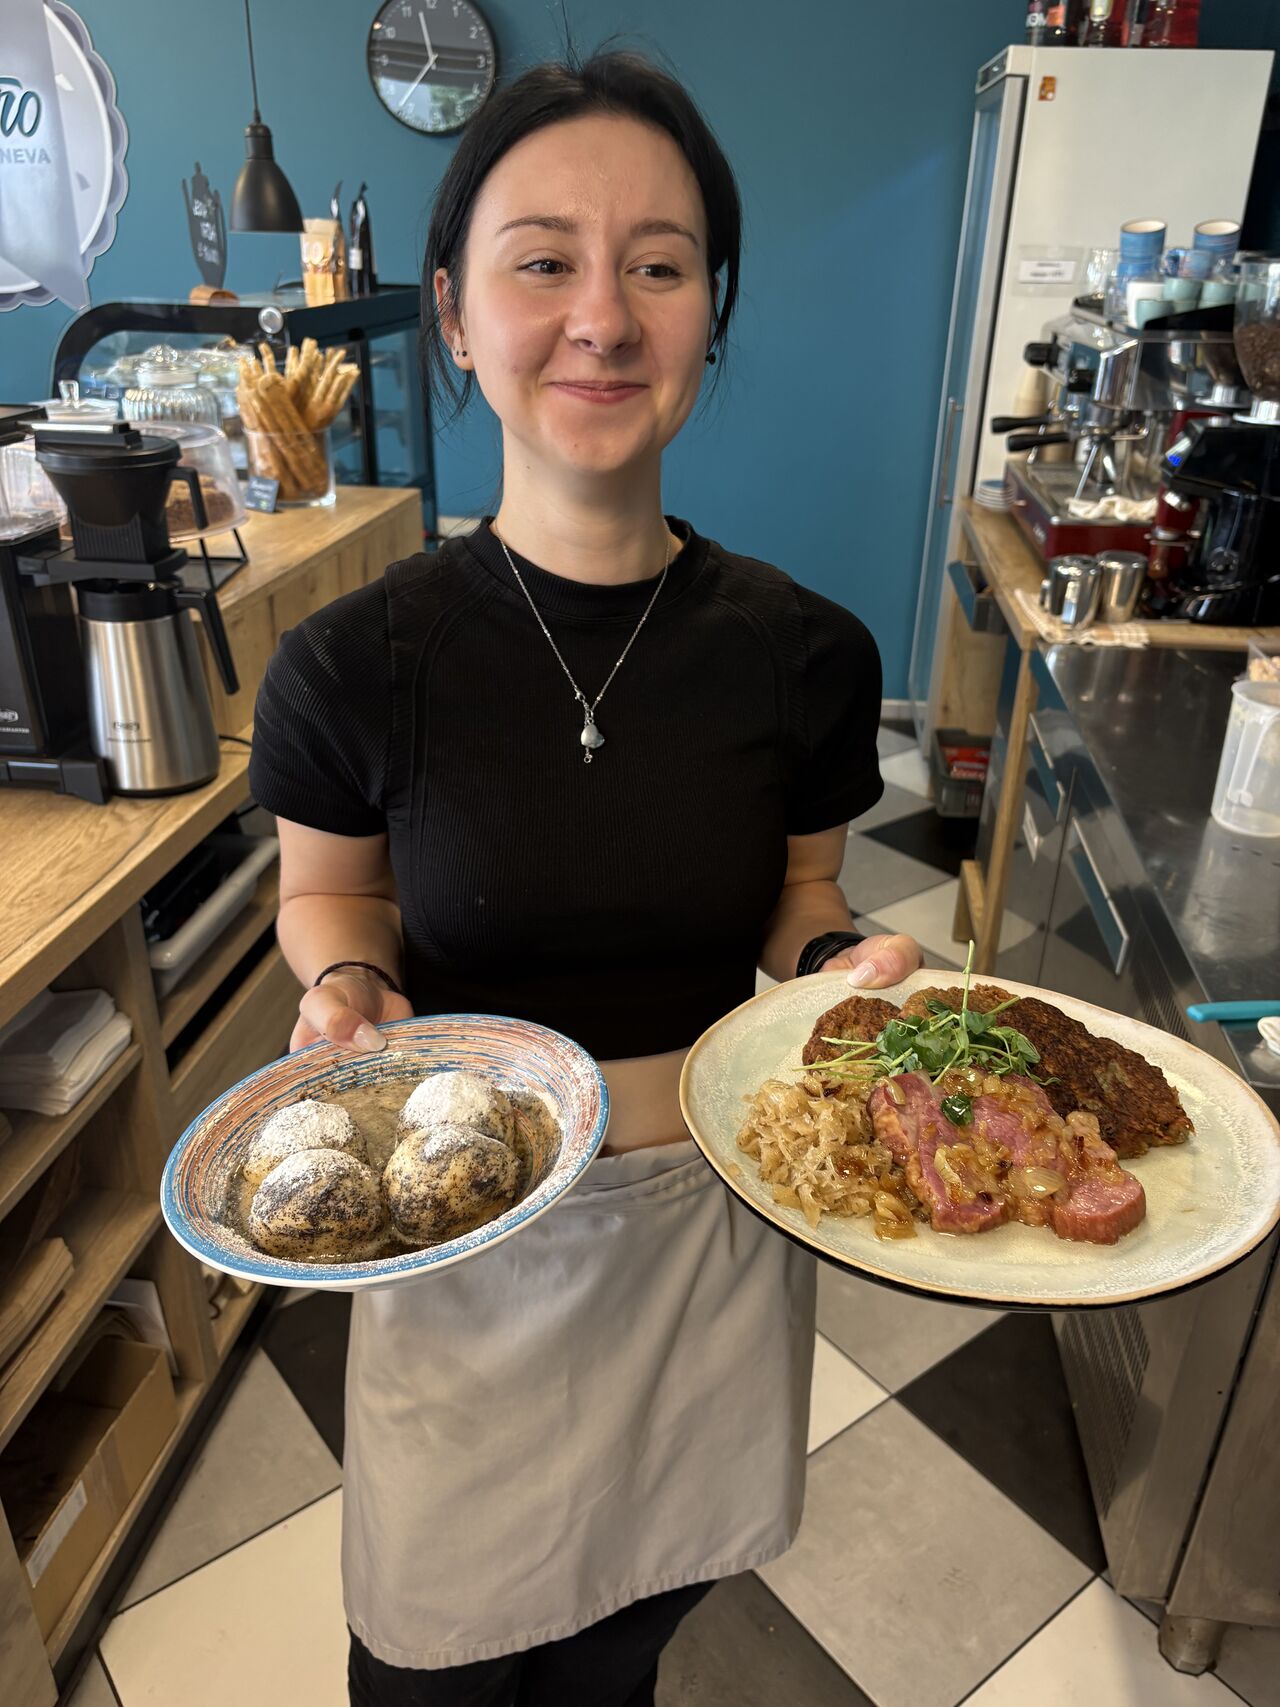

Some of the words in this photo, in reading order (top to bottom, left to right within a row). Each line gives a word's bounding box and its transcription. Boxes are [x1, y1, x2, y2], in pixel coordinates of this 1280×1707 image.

[402, 6, 412, 17] 11
[452, 5, 459, 17] 1
[385, 27, 396, 39] 10
[469, 26, 479, 39] 2
[476, 55, 486, 68] 3
